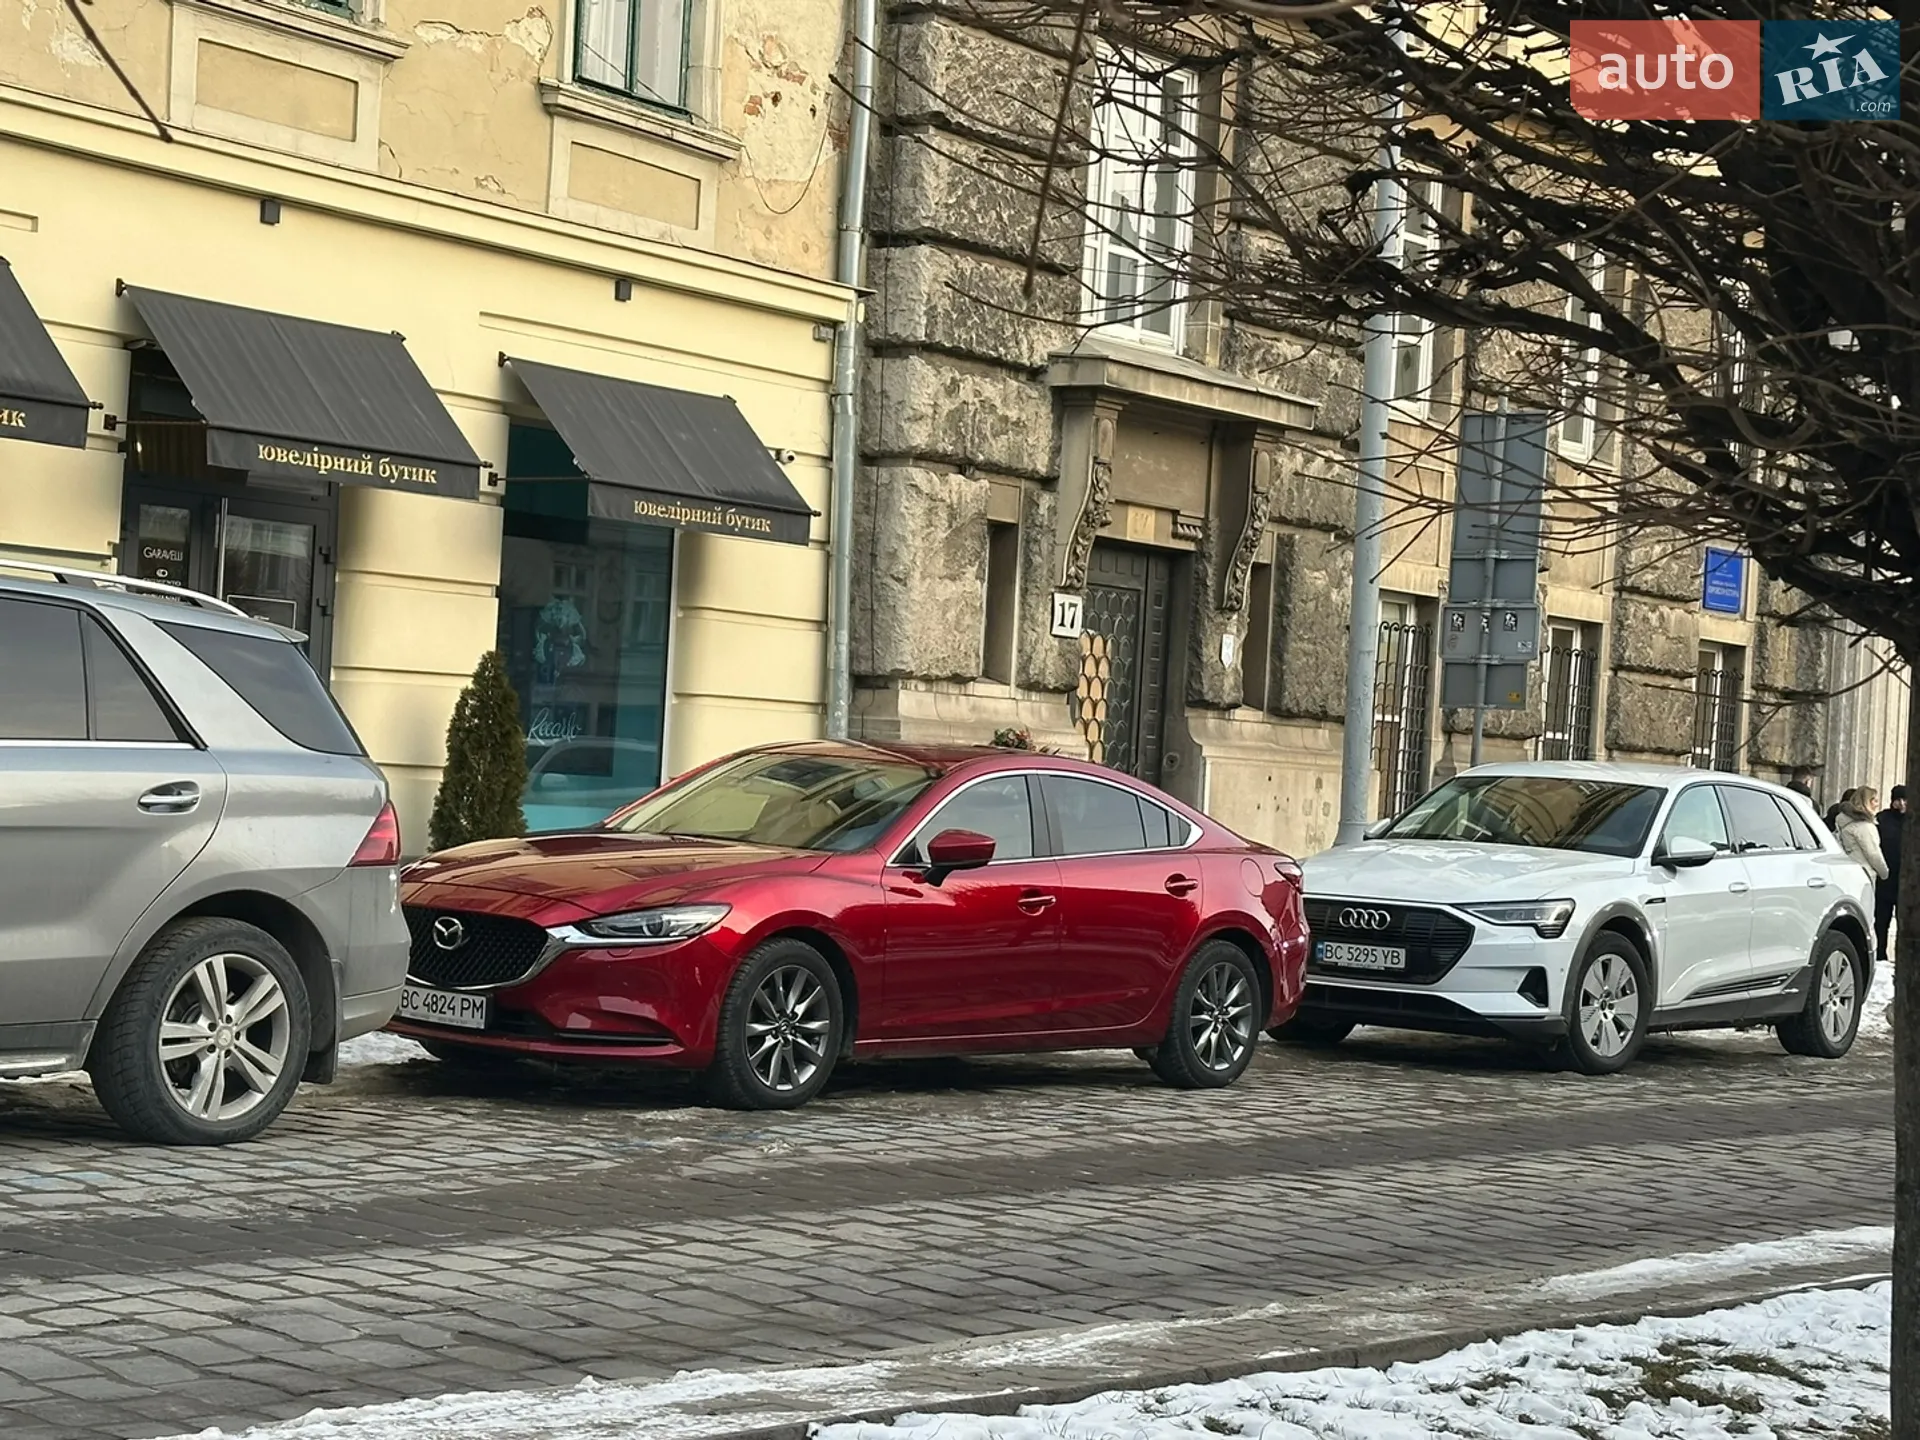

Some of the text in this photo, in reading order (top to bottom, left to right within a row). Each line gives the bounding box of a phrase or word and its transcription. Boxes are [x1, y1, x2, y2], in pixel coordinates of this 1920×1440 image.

[257, 443, 437, 484] ювелірний бутик
[634, 500, 771, 532] ювелірний бутик
[1058, 601, 1078, 629] 17
[1324, 943, 1343, 960] BC
[1346, 946, 1378, 964] 5295
[401, 989, 484, 1020] BC 4824 PM
